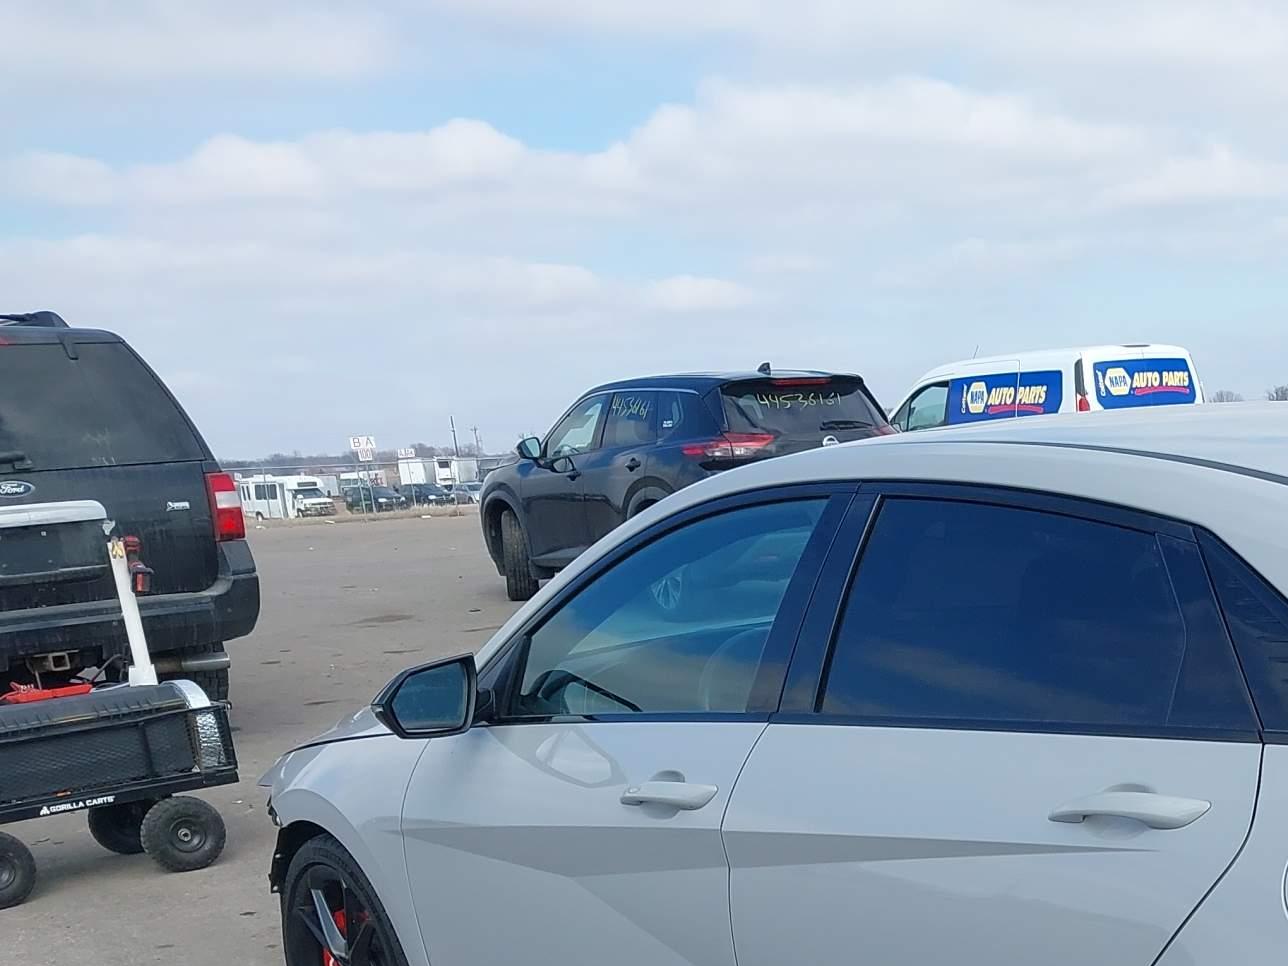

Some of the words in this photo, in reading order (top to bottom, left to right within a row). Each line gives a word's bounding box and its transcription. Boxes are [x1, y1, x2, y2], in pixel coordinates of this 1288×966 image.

[1109, 375, 1129, 389] NAPA
[1132, 371, 1160, 388] AUTO
[1162, 371, 1189, 387] PARTS
[756, 392, 841, 409] 44536161
[970, 389, 985, 405] NAPA
[987, 386, 1015, 406] AUTO
[1016, 385, 1048, 405] PARTS
[352, 437, 361, 447] B
[0, 483, 25, 494] Ford
[49, 801, 85, 813] GORILLA
[85, 796, 116, 807] CARTS
